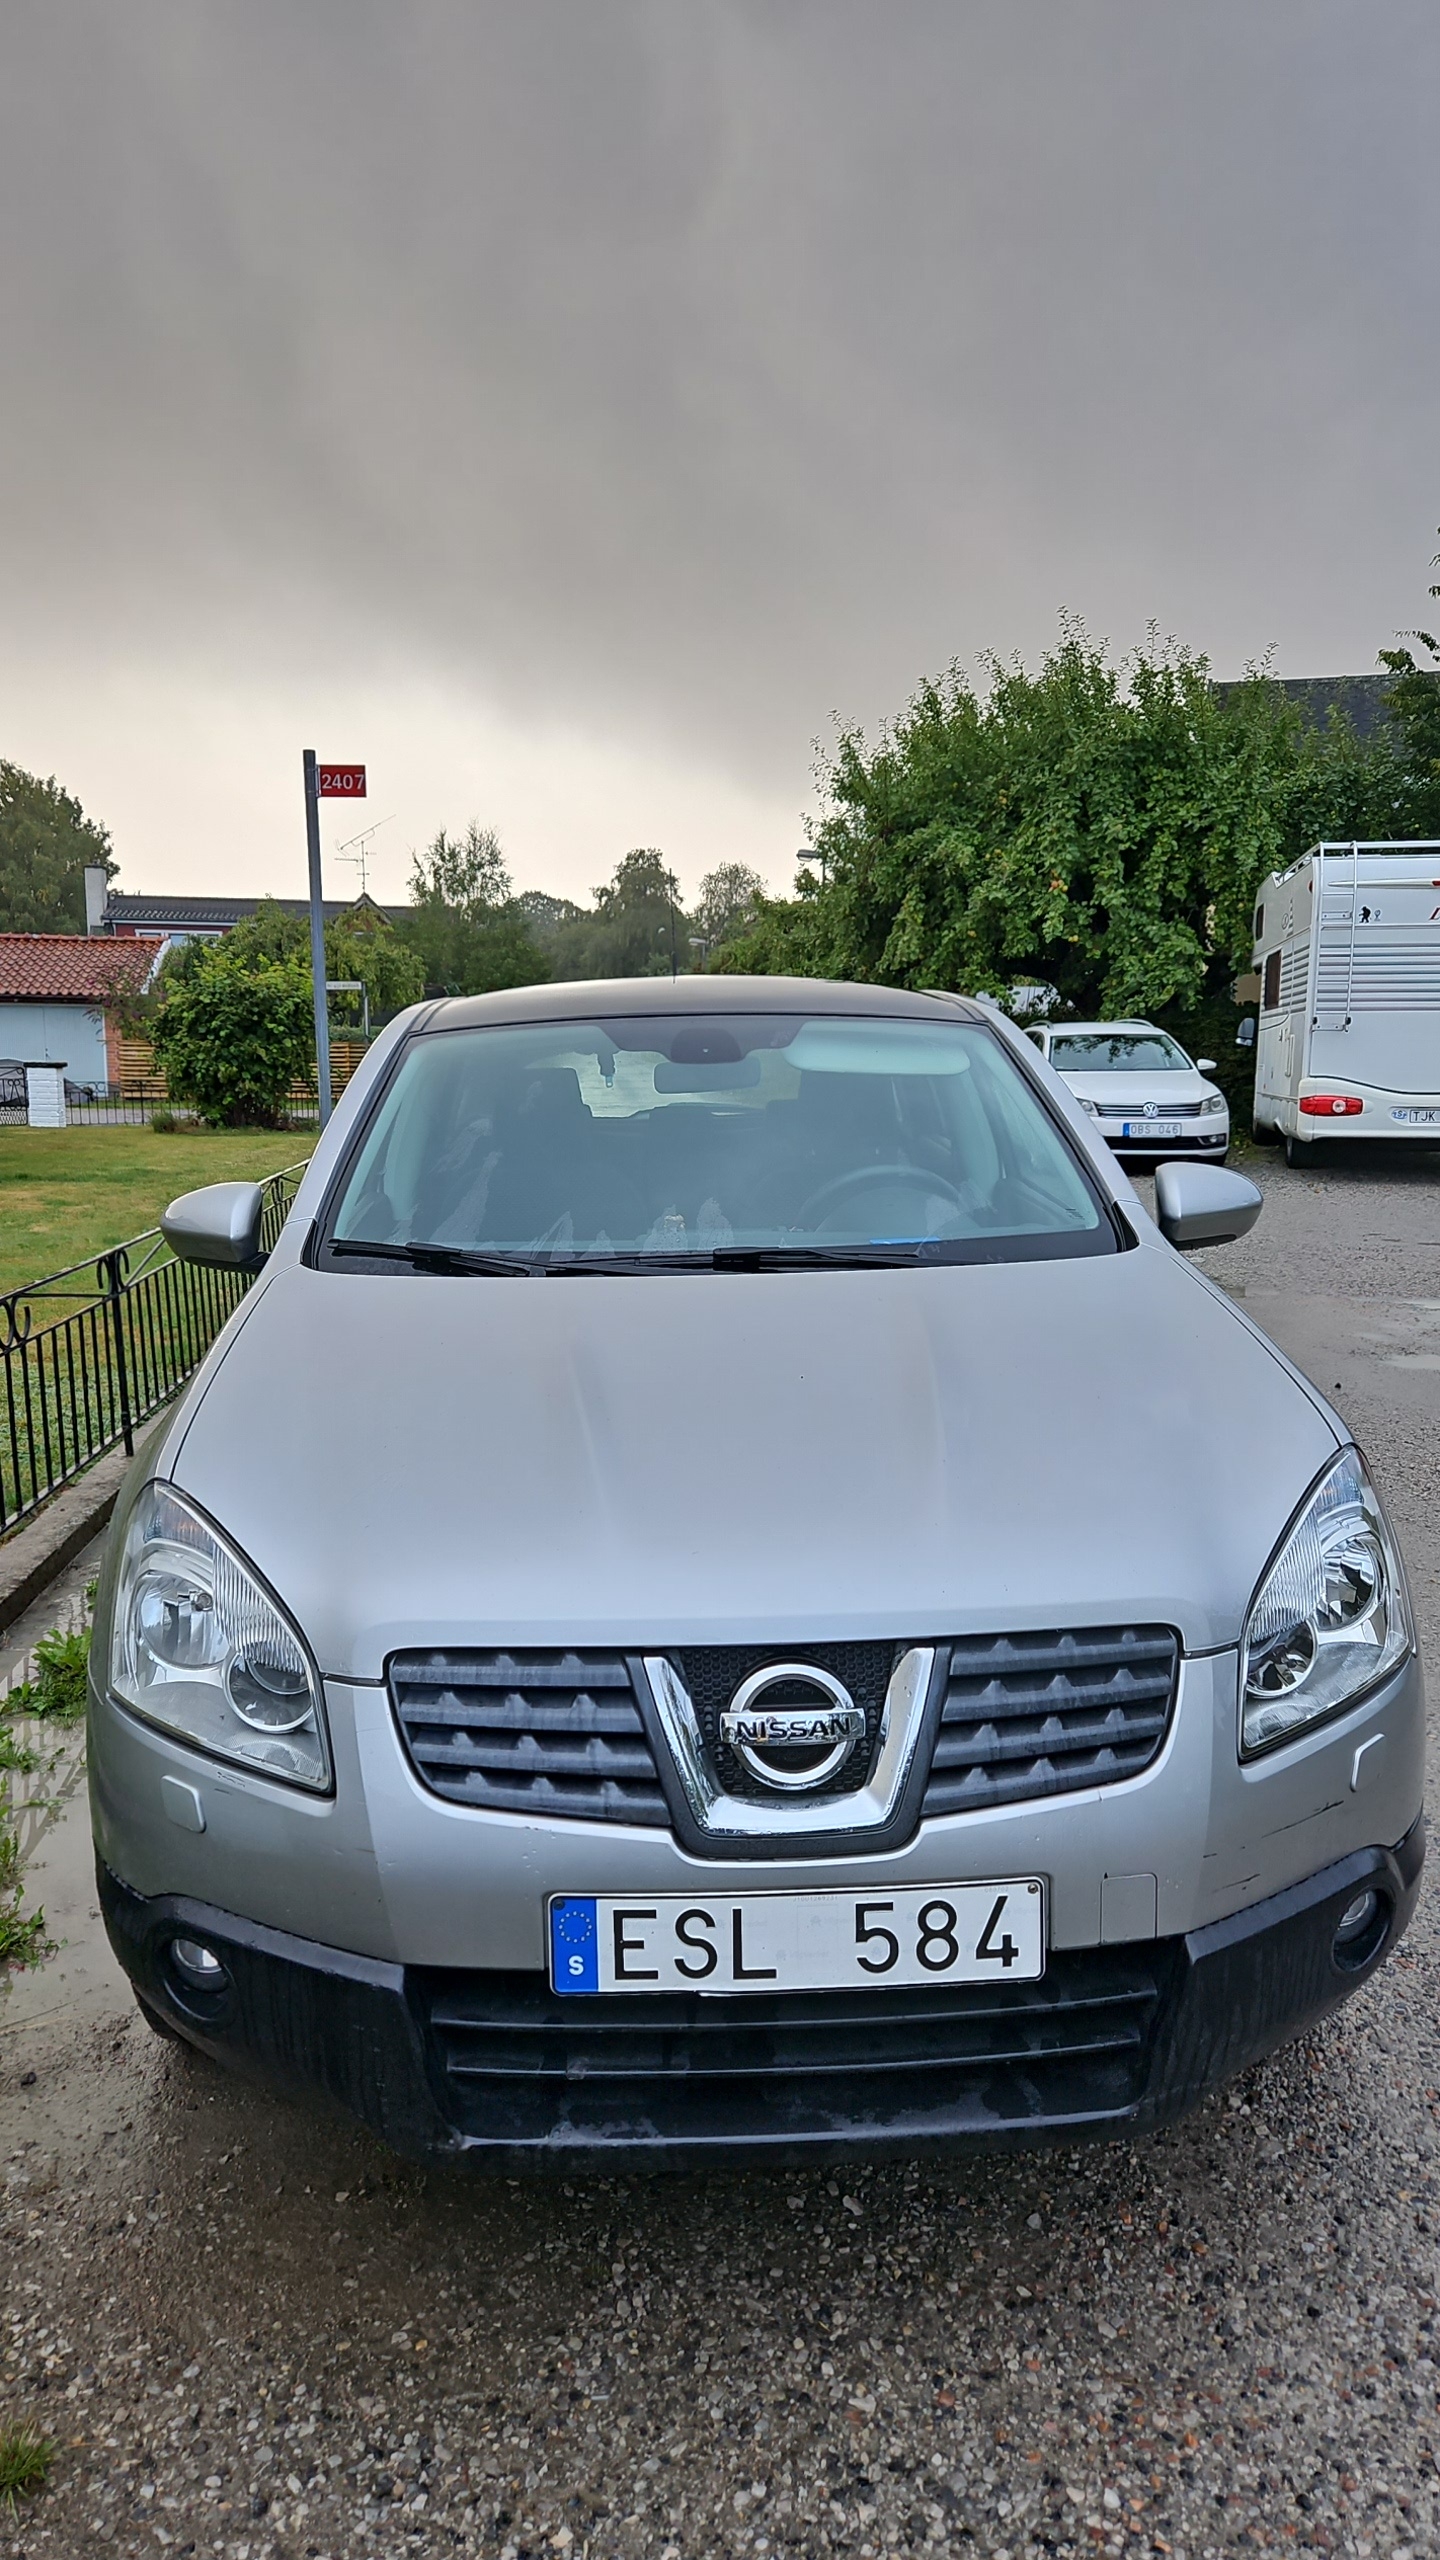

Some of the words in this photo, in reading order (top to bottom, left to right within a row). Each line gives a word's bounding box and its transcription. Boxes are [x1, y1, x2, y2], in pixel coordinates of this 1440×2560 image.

[321, 773, 365, 790] 2407
[1413, 1111, 1435, 1122] TJK
[1158, 1125, 1179, 1134] 046
[736, 1717, 851, 1739] NISSAN
[613, 1908, 777, 1980] ESL
[855, 1895, 1019, 1974] 584
[568, 1955, 584, 1976] S
